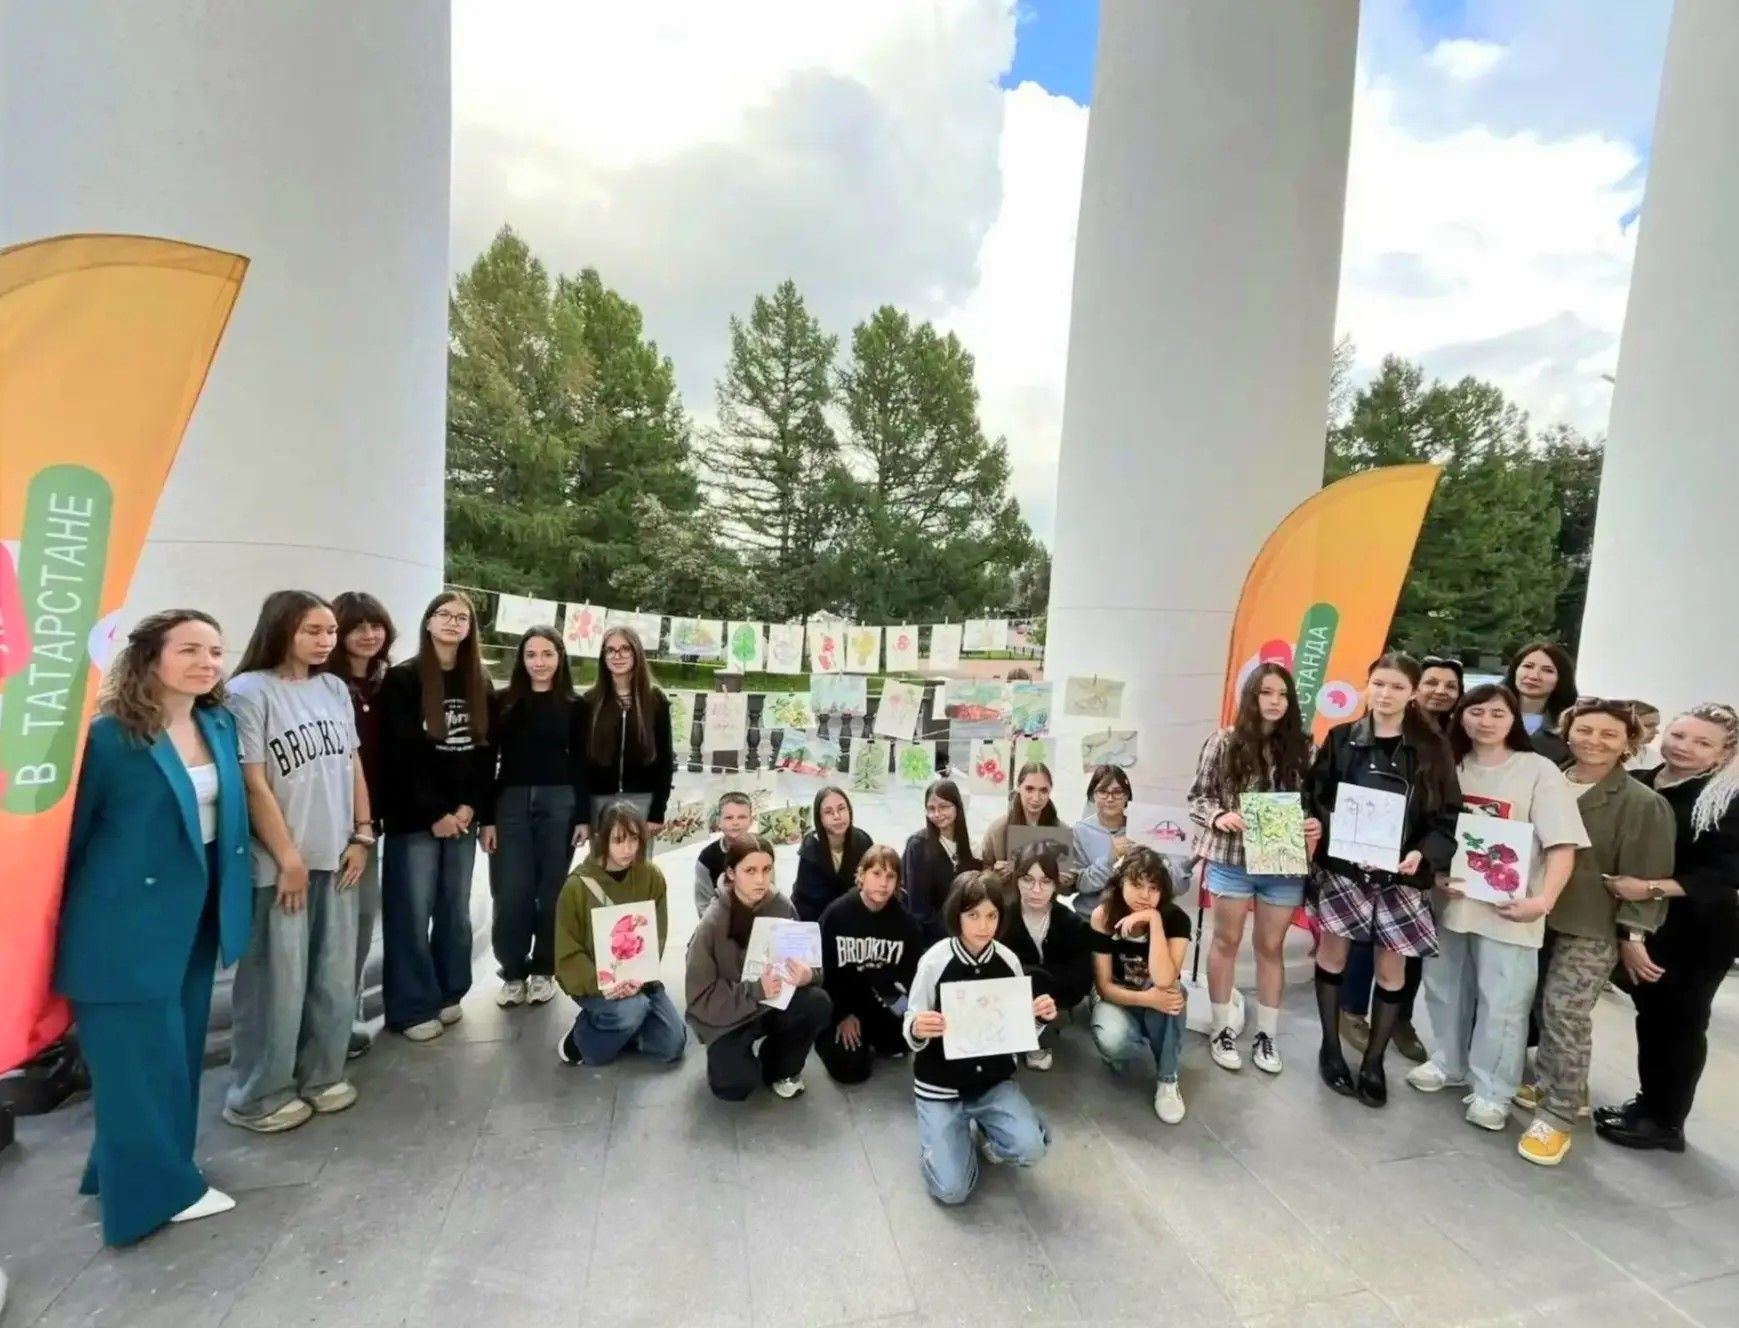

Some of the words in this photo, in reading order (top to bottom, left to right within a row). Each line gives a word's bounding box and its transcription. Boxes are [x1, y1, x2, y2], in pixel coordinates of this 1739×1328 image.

[22, 492, 94, 736] ТАТАРСТАНЕ
[1296, 626, 1329, 722] СТАНДА
[16, 763, 57, 786] В
